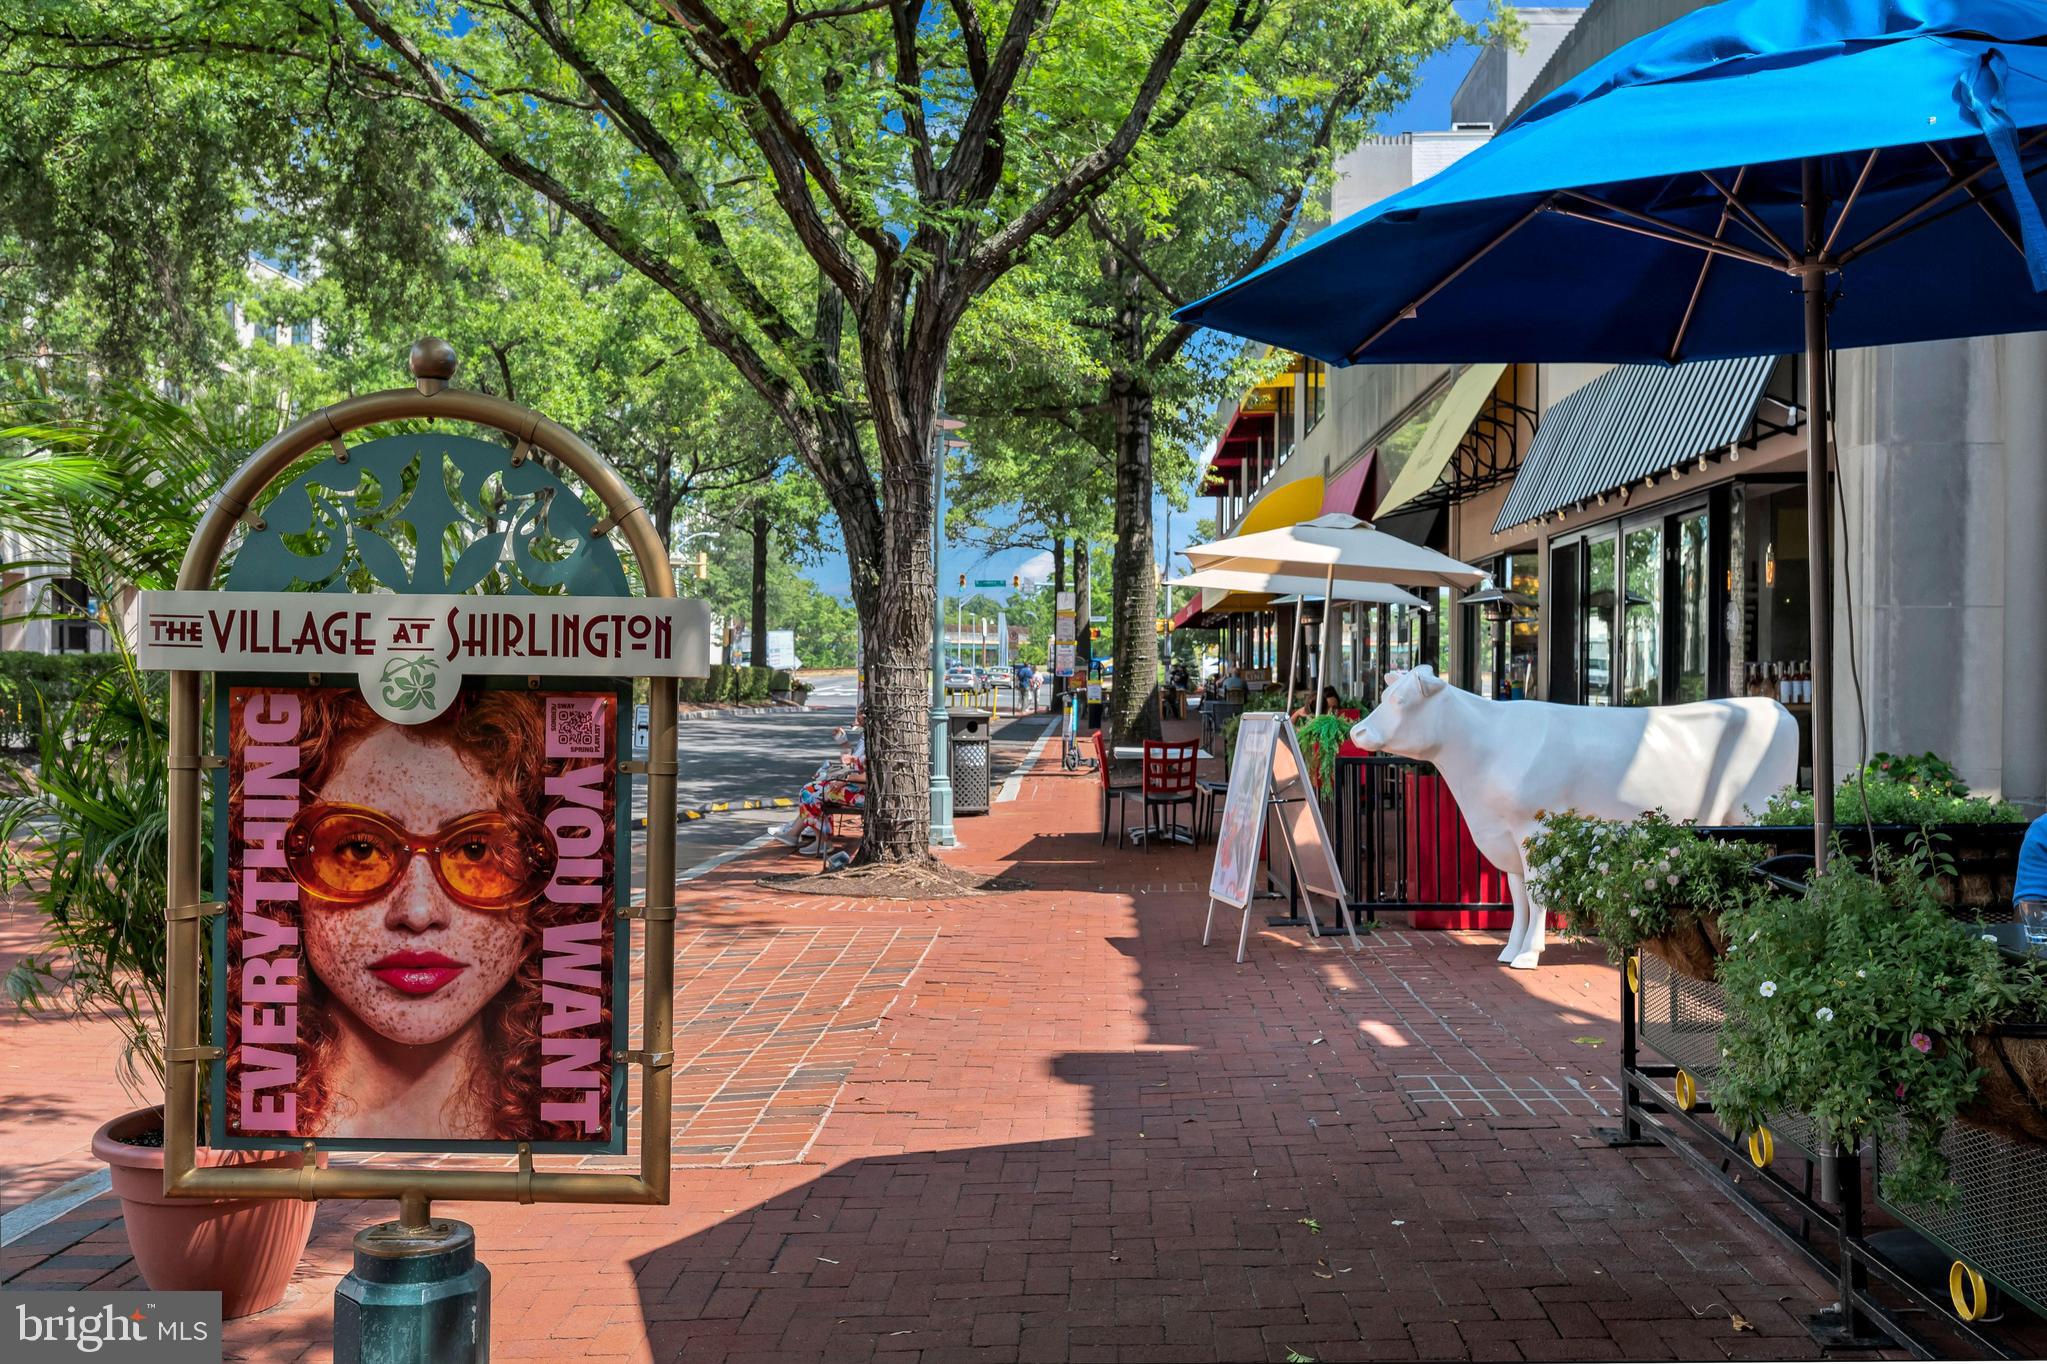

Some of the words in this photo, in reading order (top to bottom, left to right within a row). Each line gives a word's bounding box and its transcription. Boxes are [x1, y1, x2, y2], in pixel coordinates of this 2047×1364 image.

[149, 619, 203, 641] THE
[208, 609, 376, 655] VILLAGE
[392, 622, 430, 644] AT
[447, 606, 673, 662] SHIRLINGTON
[242, 694, 301, 1131] EVERYTHING
[543, 764, 604, 903] YOU
[540, 922, 604, 1134] WANT
